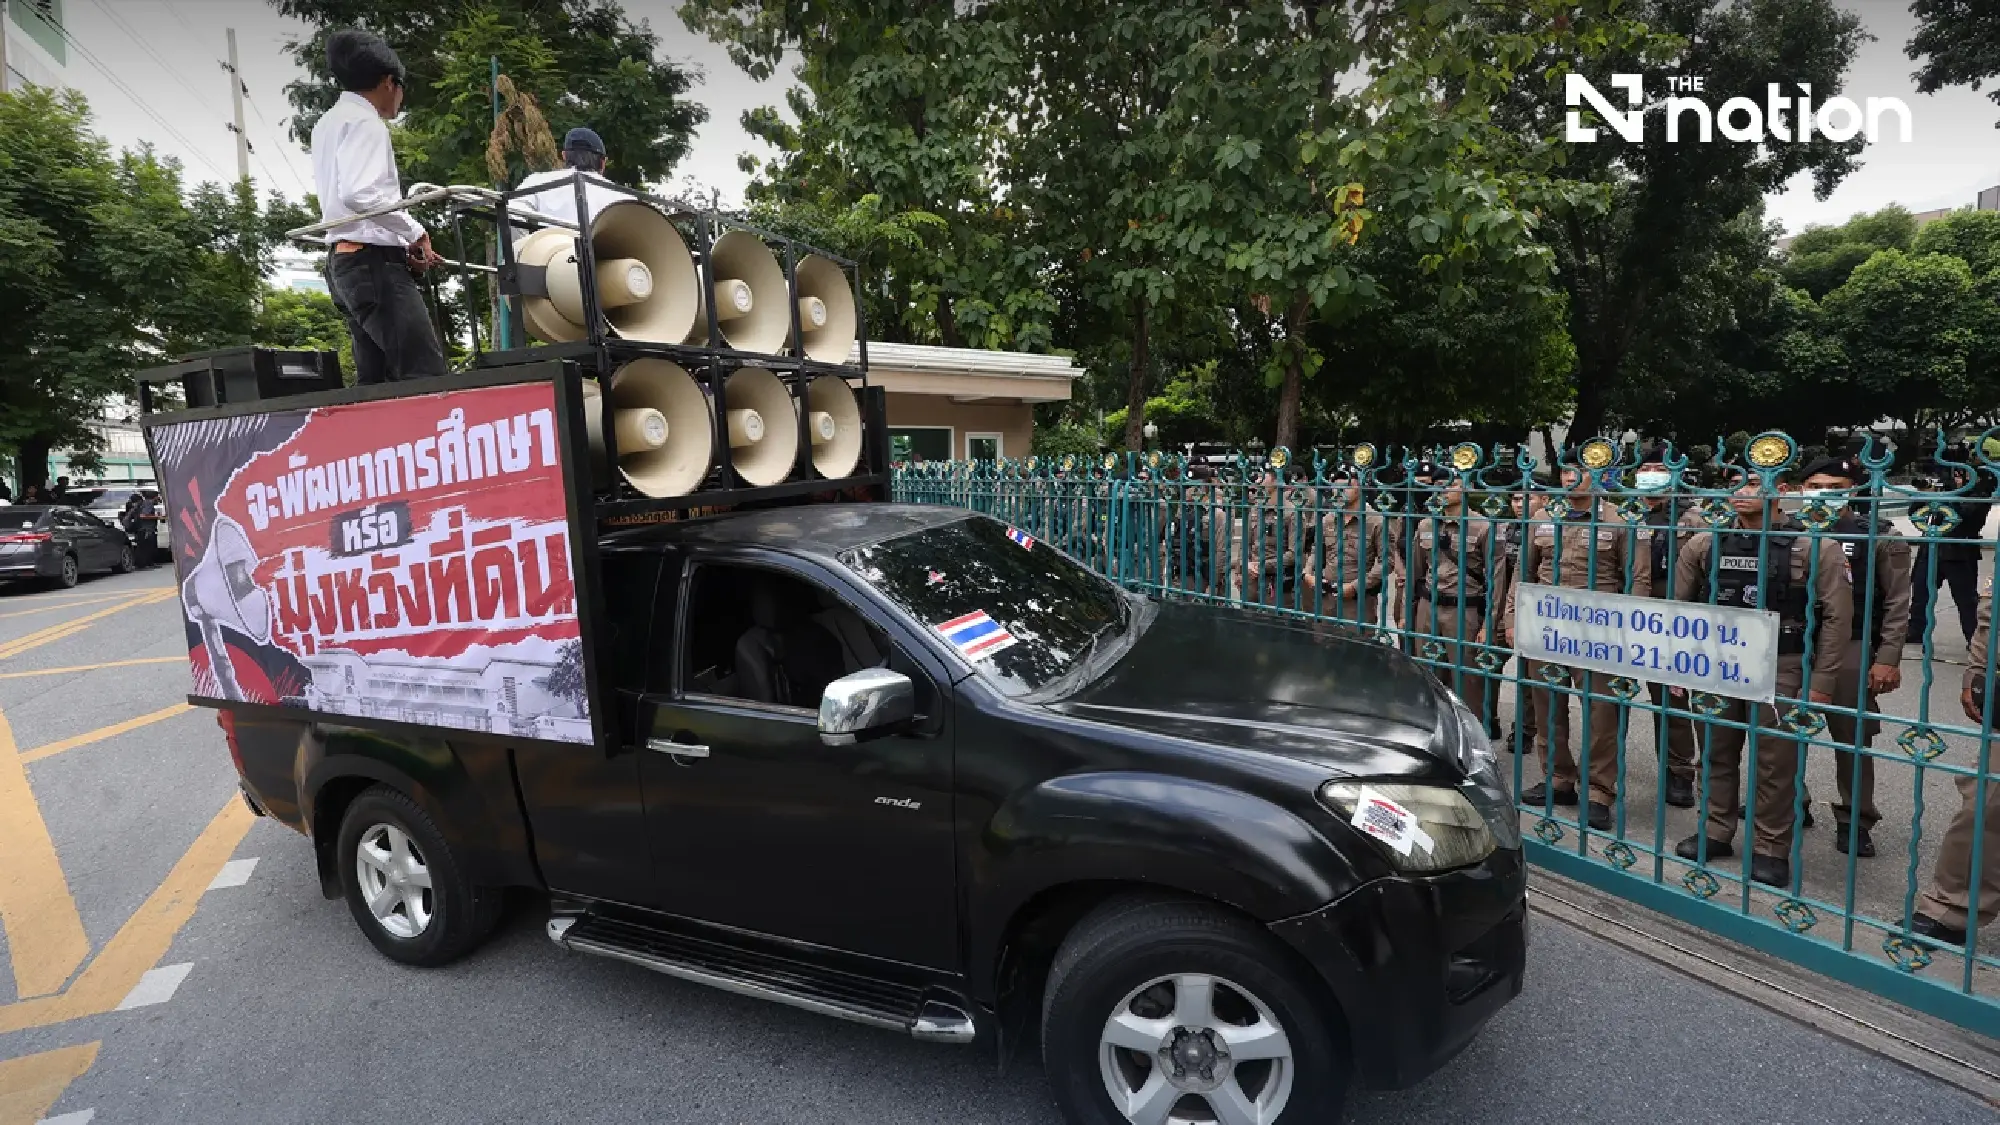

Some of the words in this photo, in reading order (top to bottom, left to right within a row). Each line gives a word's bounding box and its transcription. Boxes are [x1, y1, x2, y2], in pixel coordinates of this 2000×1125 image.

[246, 407, 557, 531] จะพัฒนาการศึกษา
[342, 504, 399, 552] หรือ
[1537, 594, 1623, 628] เปิดเวลา
[1631, 609, 1709, 640] 06.00
[1717, 625, 1747, 647] น.
[1543, 626, 1623, 663] ปิดเวลา
[1631, 644, 1710, 677] 21.00
[1718, 661, 1750, 684] น.
